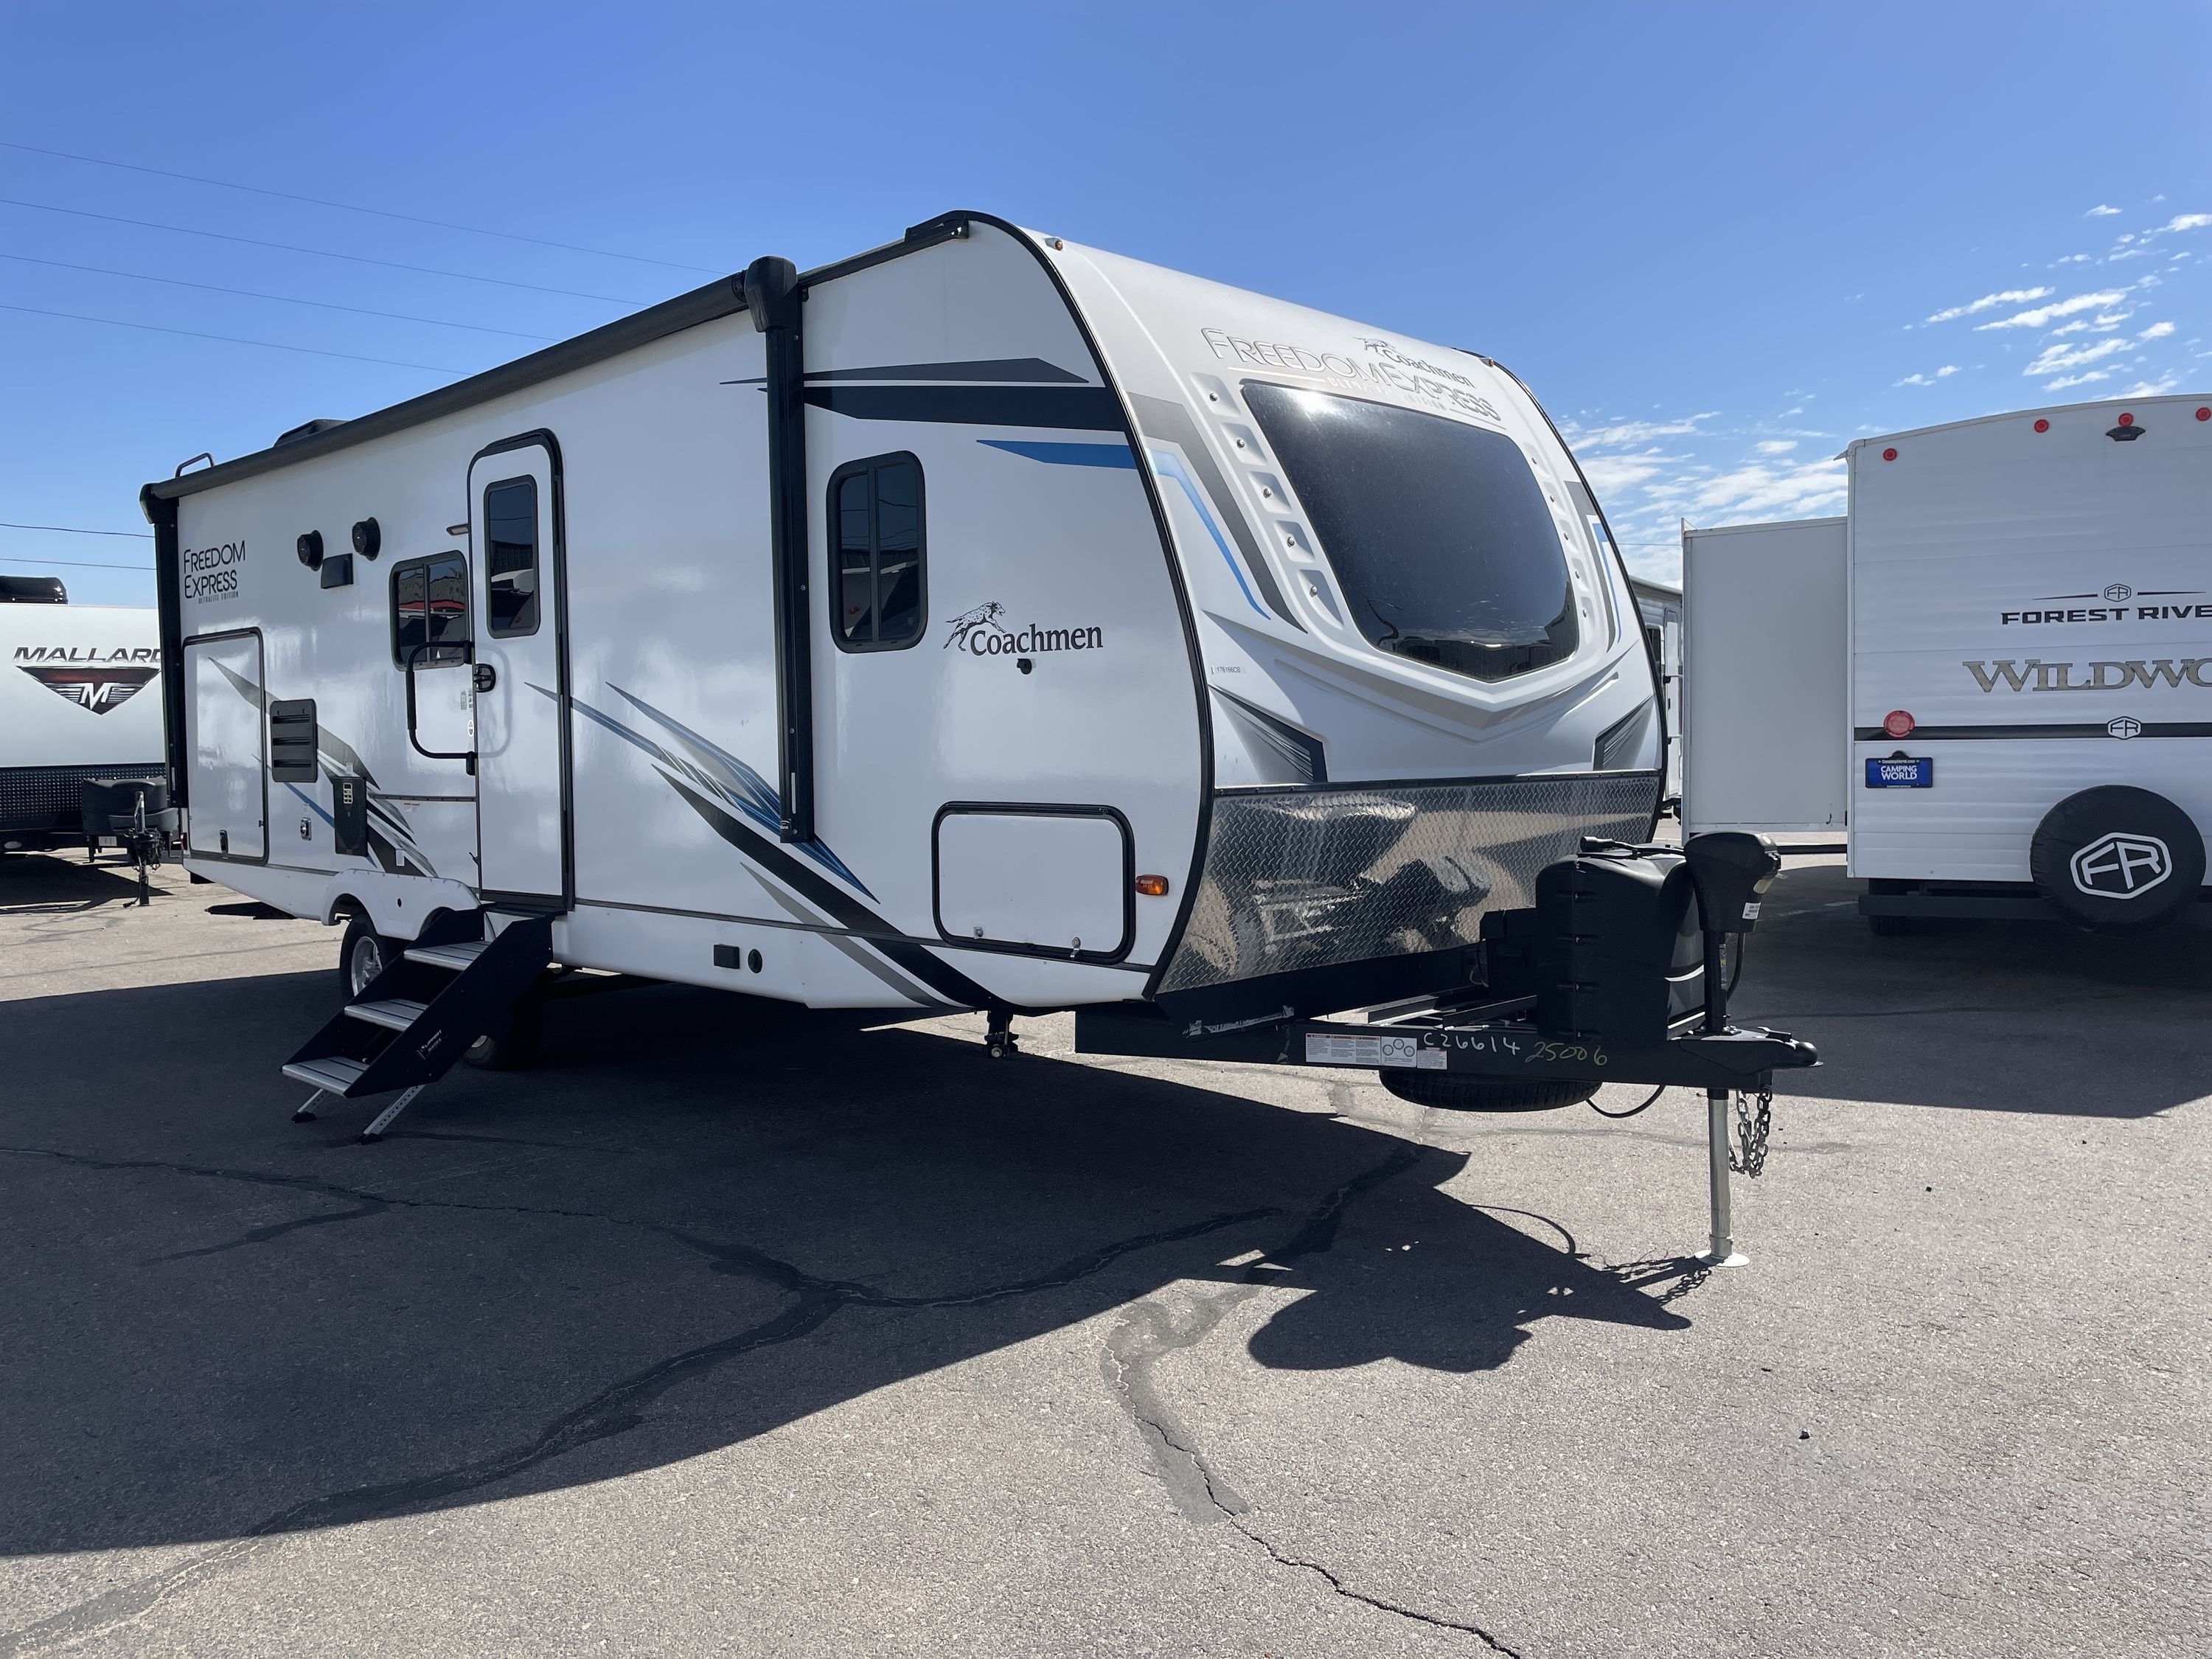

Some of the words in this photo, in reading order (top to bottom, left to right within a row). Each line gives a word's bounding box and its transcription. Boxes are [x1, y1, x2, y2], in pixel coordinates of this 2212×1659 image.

[1382, 349, 1477, 389] Coachmen
[184, 540, 246, 574] FREEDOM
[184, 569, 237, 599] EXPRESS
[2000, 608, 2129, 625] FOREST
[970, 623, 1104, 656] Coachmen
[1881, 772, 1918, 780] WORLD
[1525, 1041, 1608, 1065] 25006
